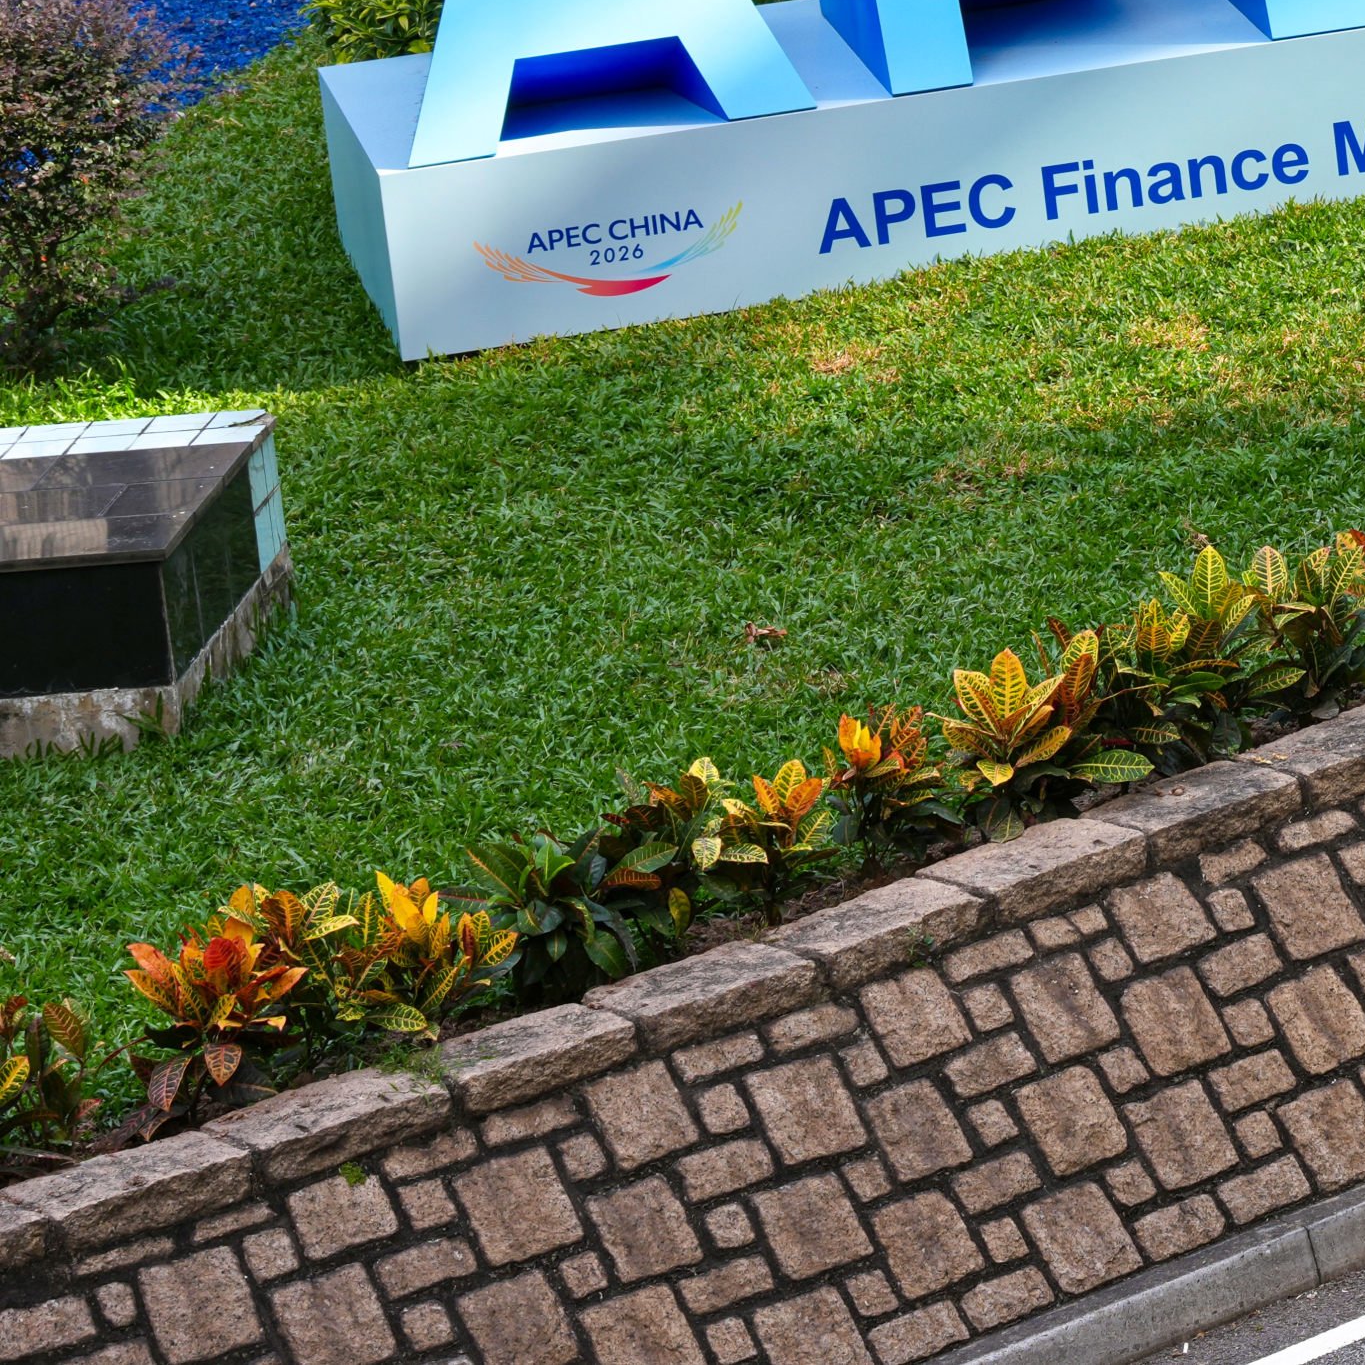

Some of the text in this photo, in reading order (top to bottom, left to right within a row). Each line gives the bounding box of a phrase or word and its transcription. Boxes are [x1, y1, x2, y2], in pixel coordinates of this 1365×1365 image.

[818, 173, 1016, 255] APEC
[1041, 142, 1309, 221] Finance
[527, 208, 704, 254] APEC CHINA
[589, 243, 645, 266] 2026
